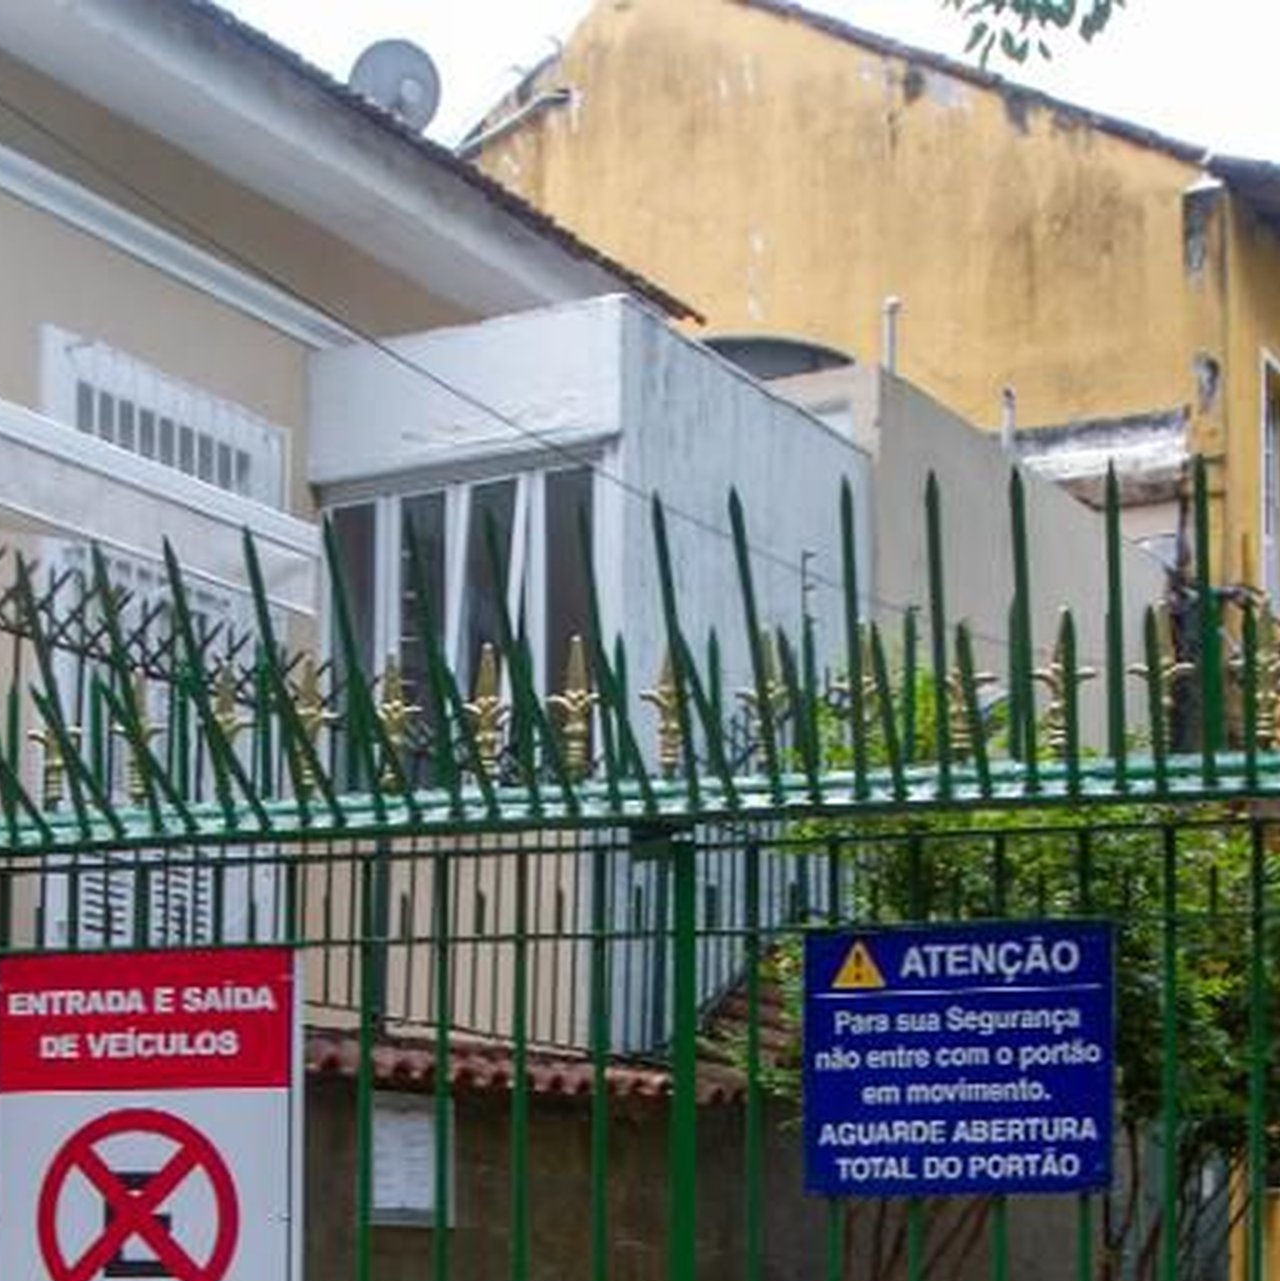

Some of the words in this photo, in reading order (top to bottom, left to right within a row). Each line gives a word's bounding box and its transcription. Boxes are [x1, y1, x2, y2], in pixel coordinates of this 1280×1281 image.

[900, 935, 1080, 983] ATENÇÃO
[7, 988, 146, 1016] ENTRADA
[153, 986, 175, 1013] E
[182, 979, 276, 1012] SAÍDA
[834, 1010, 889, 1034] Para
[896, 1012, 940, 1032] sua
[945, 1006, 1081, 1035] Segurança
[39, 1034, 80, 1059] DE
[86, 1027, 239, 1058] VEÍCULOS
[814, 1047, 860, 1071] não
[865, 1045, 930, 1068] entre
[935, 1046, 990, 1066] com
[995, 1046, 1013, 1065] o
[1020, 1038, 1101, 1070] portão
[861, 1083, 901, 1105] em
[906, 1077, 1052, 1103] movimento.
[819, 1120, 946, 1146] AGUARDE
[951, 1117, 1098, 1143] ABERTURA
[836, 1157, 917, 1181] TOTAL
[923, 1157, 962, 1180] DO
[967, 1147, 1080, 1178] PORTÃO
